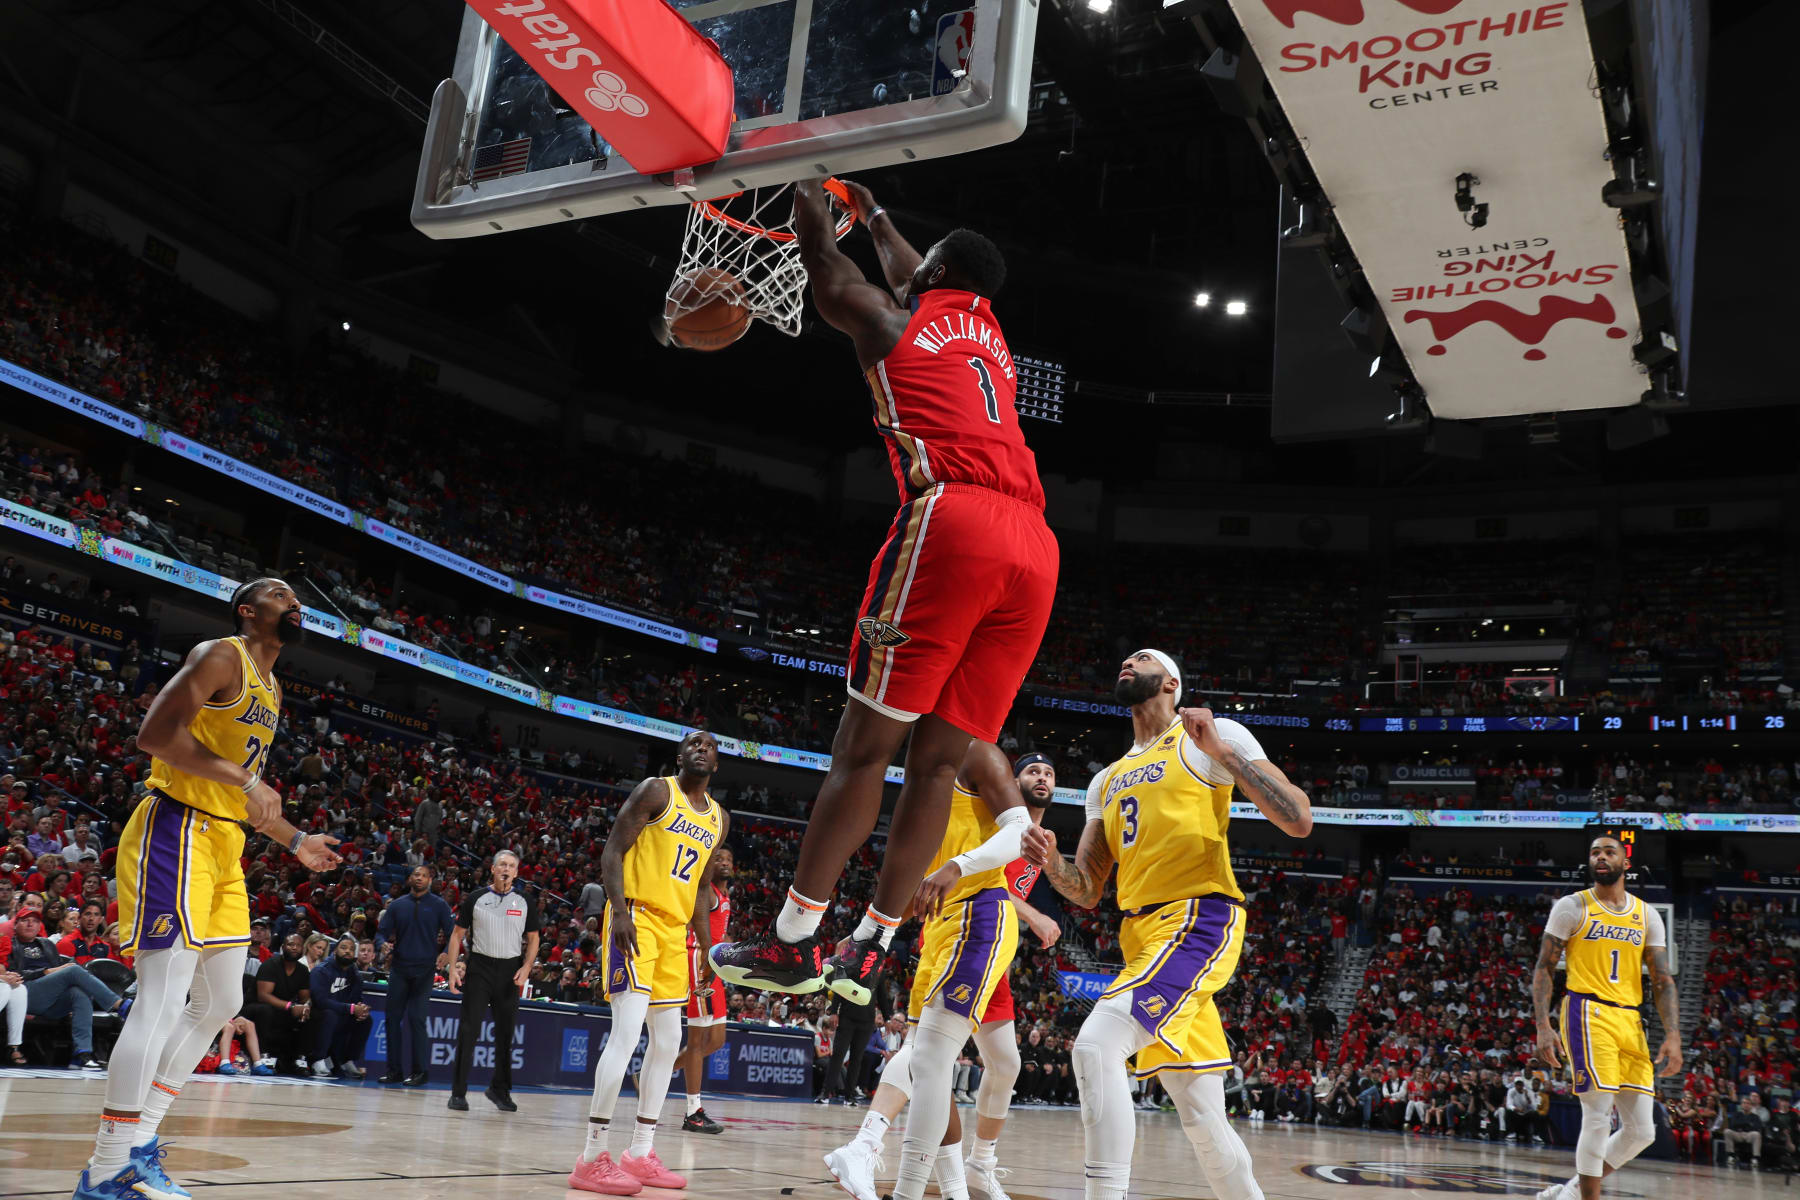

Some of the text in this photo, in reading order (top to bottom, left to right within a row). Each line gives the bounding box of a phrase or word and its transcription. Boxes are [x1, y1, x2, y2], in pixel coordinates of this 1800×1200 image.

[495, 0, 602, 70] Stat
[1279, 3, 1568, 74] SMOOTHIE
[1369, 80, 1500, 110] CENTER
[1437, 237, 1549, 259] CENTER
[1391, 264, 1620, 303] SMOOTHIE
[912, 313, 1014, 380] WILLIAMSON
[967, 356, 1001, 424] 1
[69, 396, 82, 408] AT
[82, 401, 121, 423] SECTION
[122, 417, 136, 430] 105
[169, 437, 187, 451] WIN
[202, 450, 223, 467] WITH
[305, 495, 334, 513] SECTION
[48, 523, 67, 538] 105
[112, 545, 236, 594] WIN BIG WITH WESTGAT
[21, 602, 125, 641] BETRIVERS
[301, 611, 336, 631] TION 105
[368, 635, 385, 648] WIN
[399, 645, 418, 659] WITH
[494, 679, 522, 694] SECTION
[770, 652, 846, 678] TEAM STATS
[279, 679, 320, 697] IVERS
[361, 702, 430, 732] BETRIVERS
[591, 709, 612, 719] WITH
[1385, 717, 1403, 725] TIME
[1408, 719, 1417, 731] 6
[1440, 719, 1448, 730] 3
[1465, 717, 1485, 725] TEAM
[1603, 716, 1622, 729] 29
[1660, 718, 1676, 728] 1st
[1699, 717, 1724, 729] 1:14
[1764, 716, 1785, 729] 26
[1384, 724, 1404, 732] OUTS
[1463, 724, 1487, 732] FOULS
[798, 755, 818, 764] WITH
[894, 771, 904, 779] AT
[1412, 768, 1470, 777] HUB CLUB
[1103, 759, 1168, 809] LAKERS
[1119, 794, 1140, 849] 3
[1239, 807, 1260, 815] WITH
[1604, 816, 1637, 825] ECTION
[664, 812, 715, 850] LAKERS
[1620, 830, 1636, 844] 14
[670, 843, 700, 884] 12
[1231, 857, 1304, 870] BETRIVERS
[1434, 866, 1513, 877] BETRIVERS
[1584, 920, 1643, 946] LAKERS
[1608, 949, 1620, 984] 1
[1085, 980, 1112, 992] FAN
[425, 1016, 525, 1045] AMICN
[430, 1043, 524, 1070] EXRES
[738, 1043, 805, 1066] AMERICAN
[746, 1064, 806, 1086] EXPRESS
